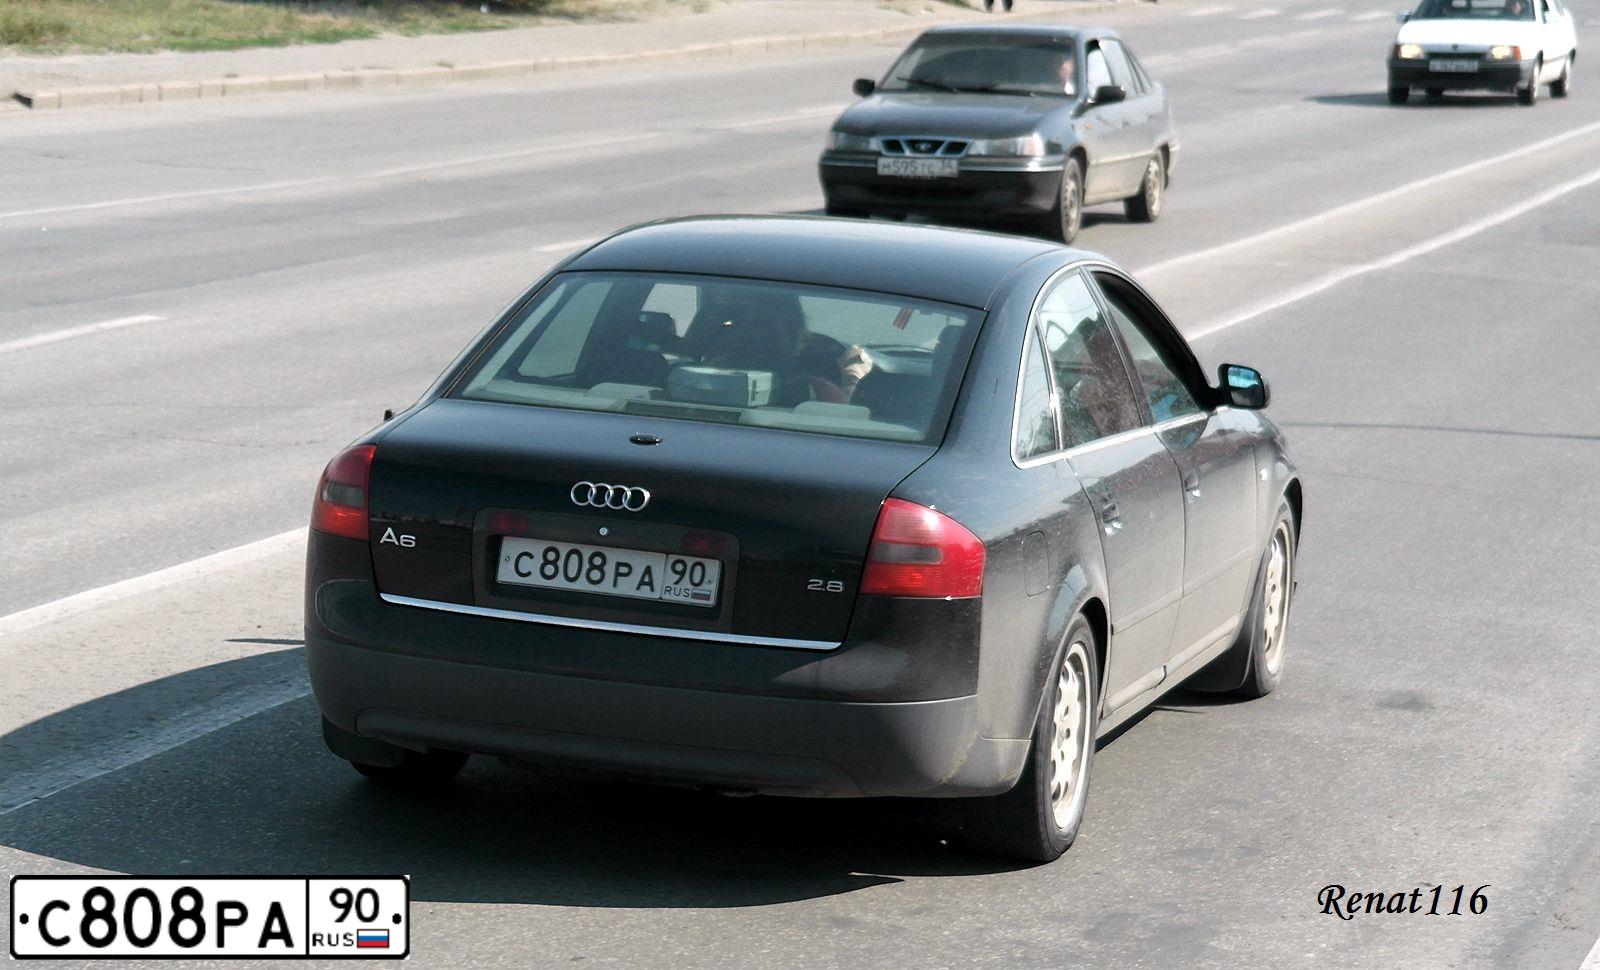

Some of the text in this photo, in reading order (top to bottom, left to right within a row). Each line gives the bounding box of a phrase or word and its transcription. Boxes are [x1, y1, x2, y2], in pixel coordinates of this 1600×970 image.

[379, 526, 416, 548] A6
[513, 546, 706, 592] C808PA 90
[664, 586, 690, 598] RUS
[807, 578, 843, 593] 2.8
